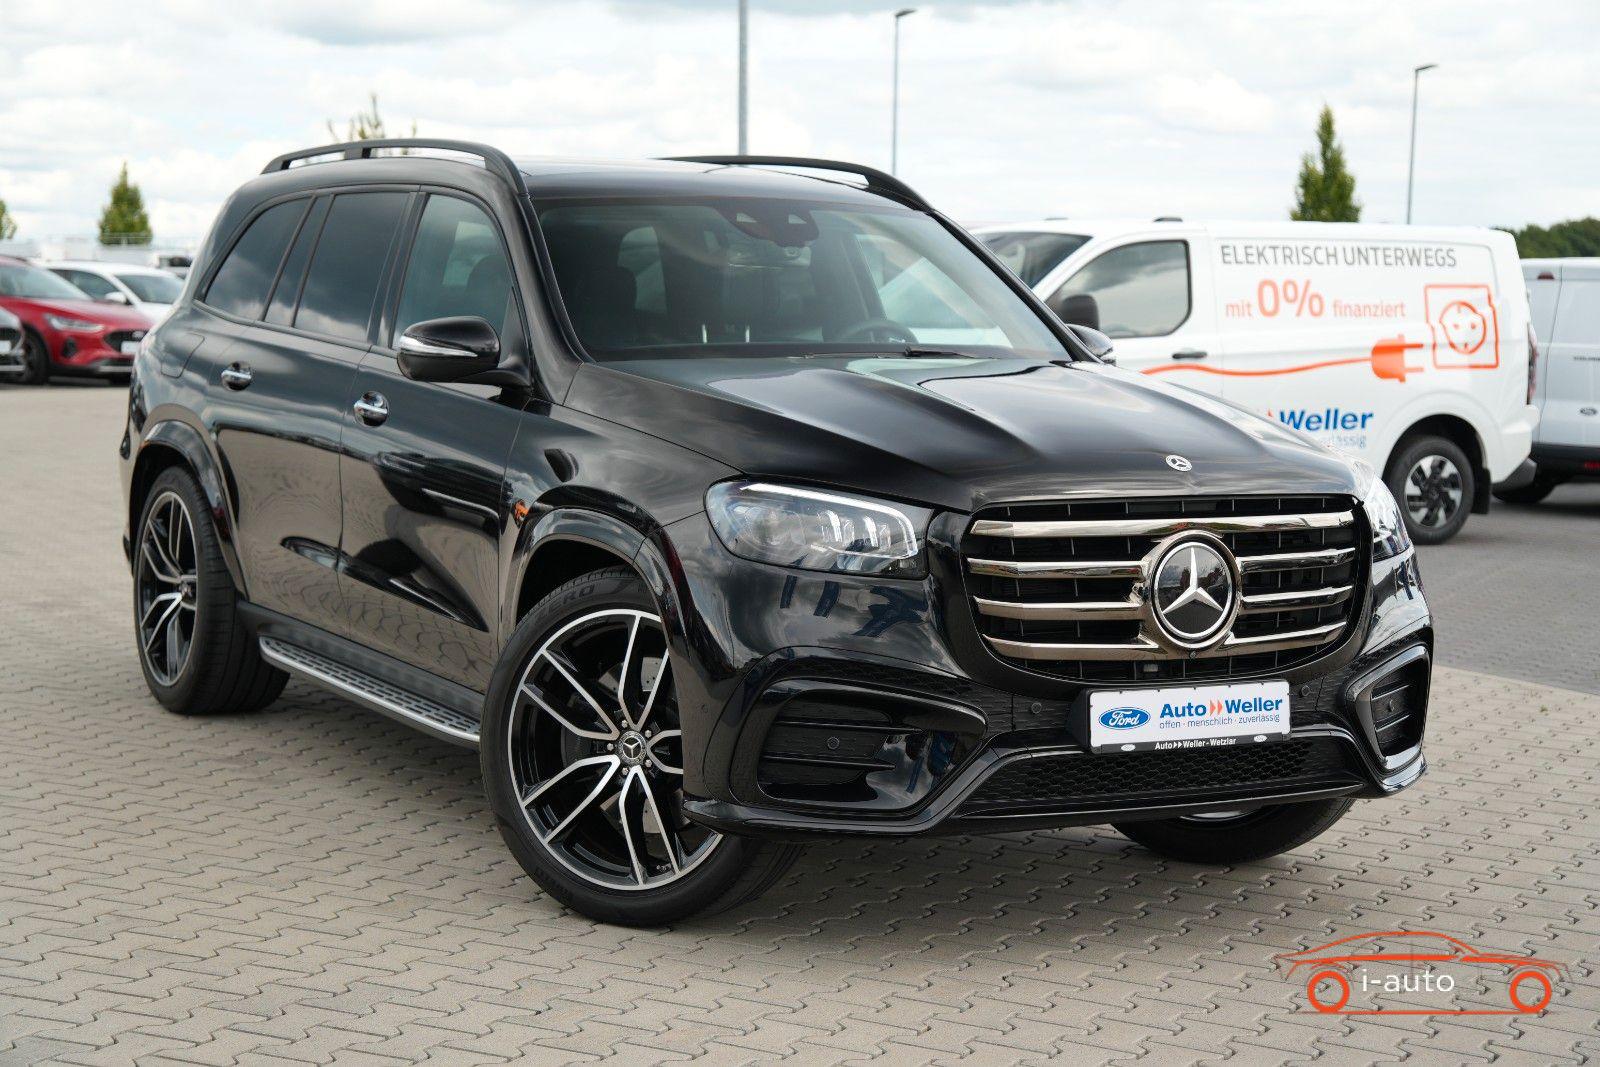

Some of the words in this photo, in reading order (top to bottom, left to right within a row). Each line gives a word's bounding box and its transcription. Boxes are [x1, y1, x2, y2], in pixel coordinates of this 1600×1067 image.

[1221, 245, 1339, 266] ELEKTRISCH
[1343, 246, 1457, 267] UNTERWEGS
[1225, 299, 1252, 317] mit
[1257, 279, 1324, 317] 0%
[1332, 299, 1406, 318] finanziert
[1279, 408, 1374, 431] Weller
[1160, 703, 1207, 718] Auto
[1225, 697, 1282, 713] Weller
[1109, 710, 1141, 727] Ford
[1159, 720, 1181, 730] offen
[1187, 716, 1233, 728] menschlich
